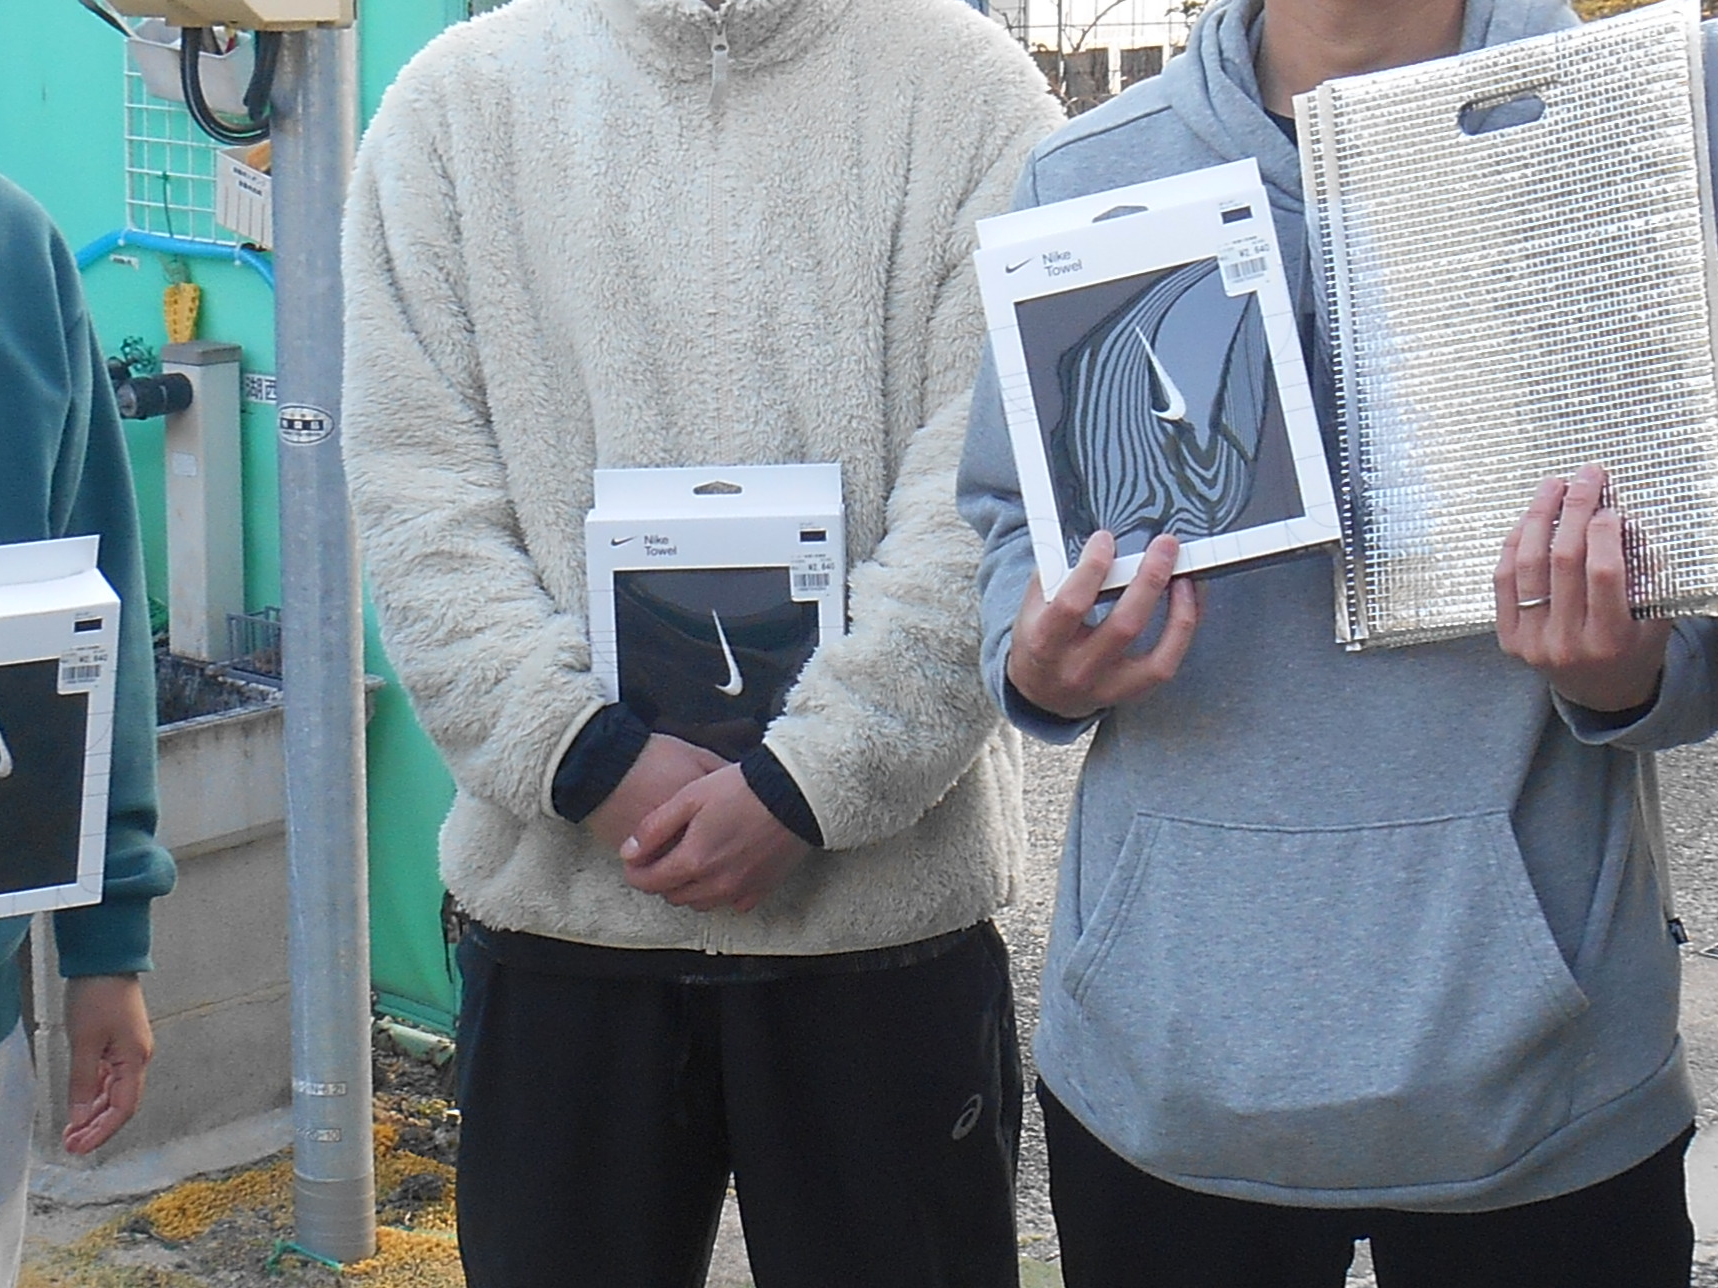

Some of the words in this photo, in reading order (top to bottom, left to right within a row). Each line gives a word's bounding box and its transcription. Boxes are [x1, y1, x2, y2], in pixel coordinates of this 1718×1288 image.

[1042, 249, 1071, 265] Nike
[1045, 259, 1083, 278] Towel
[644, 534, 669, 545] Nike
[644, 545, 678, 557] Towel
